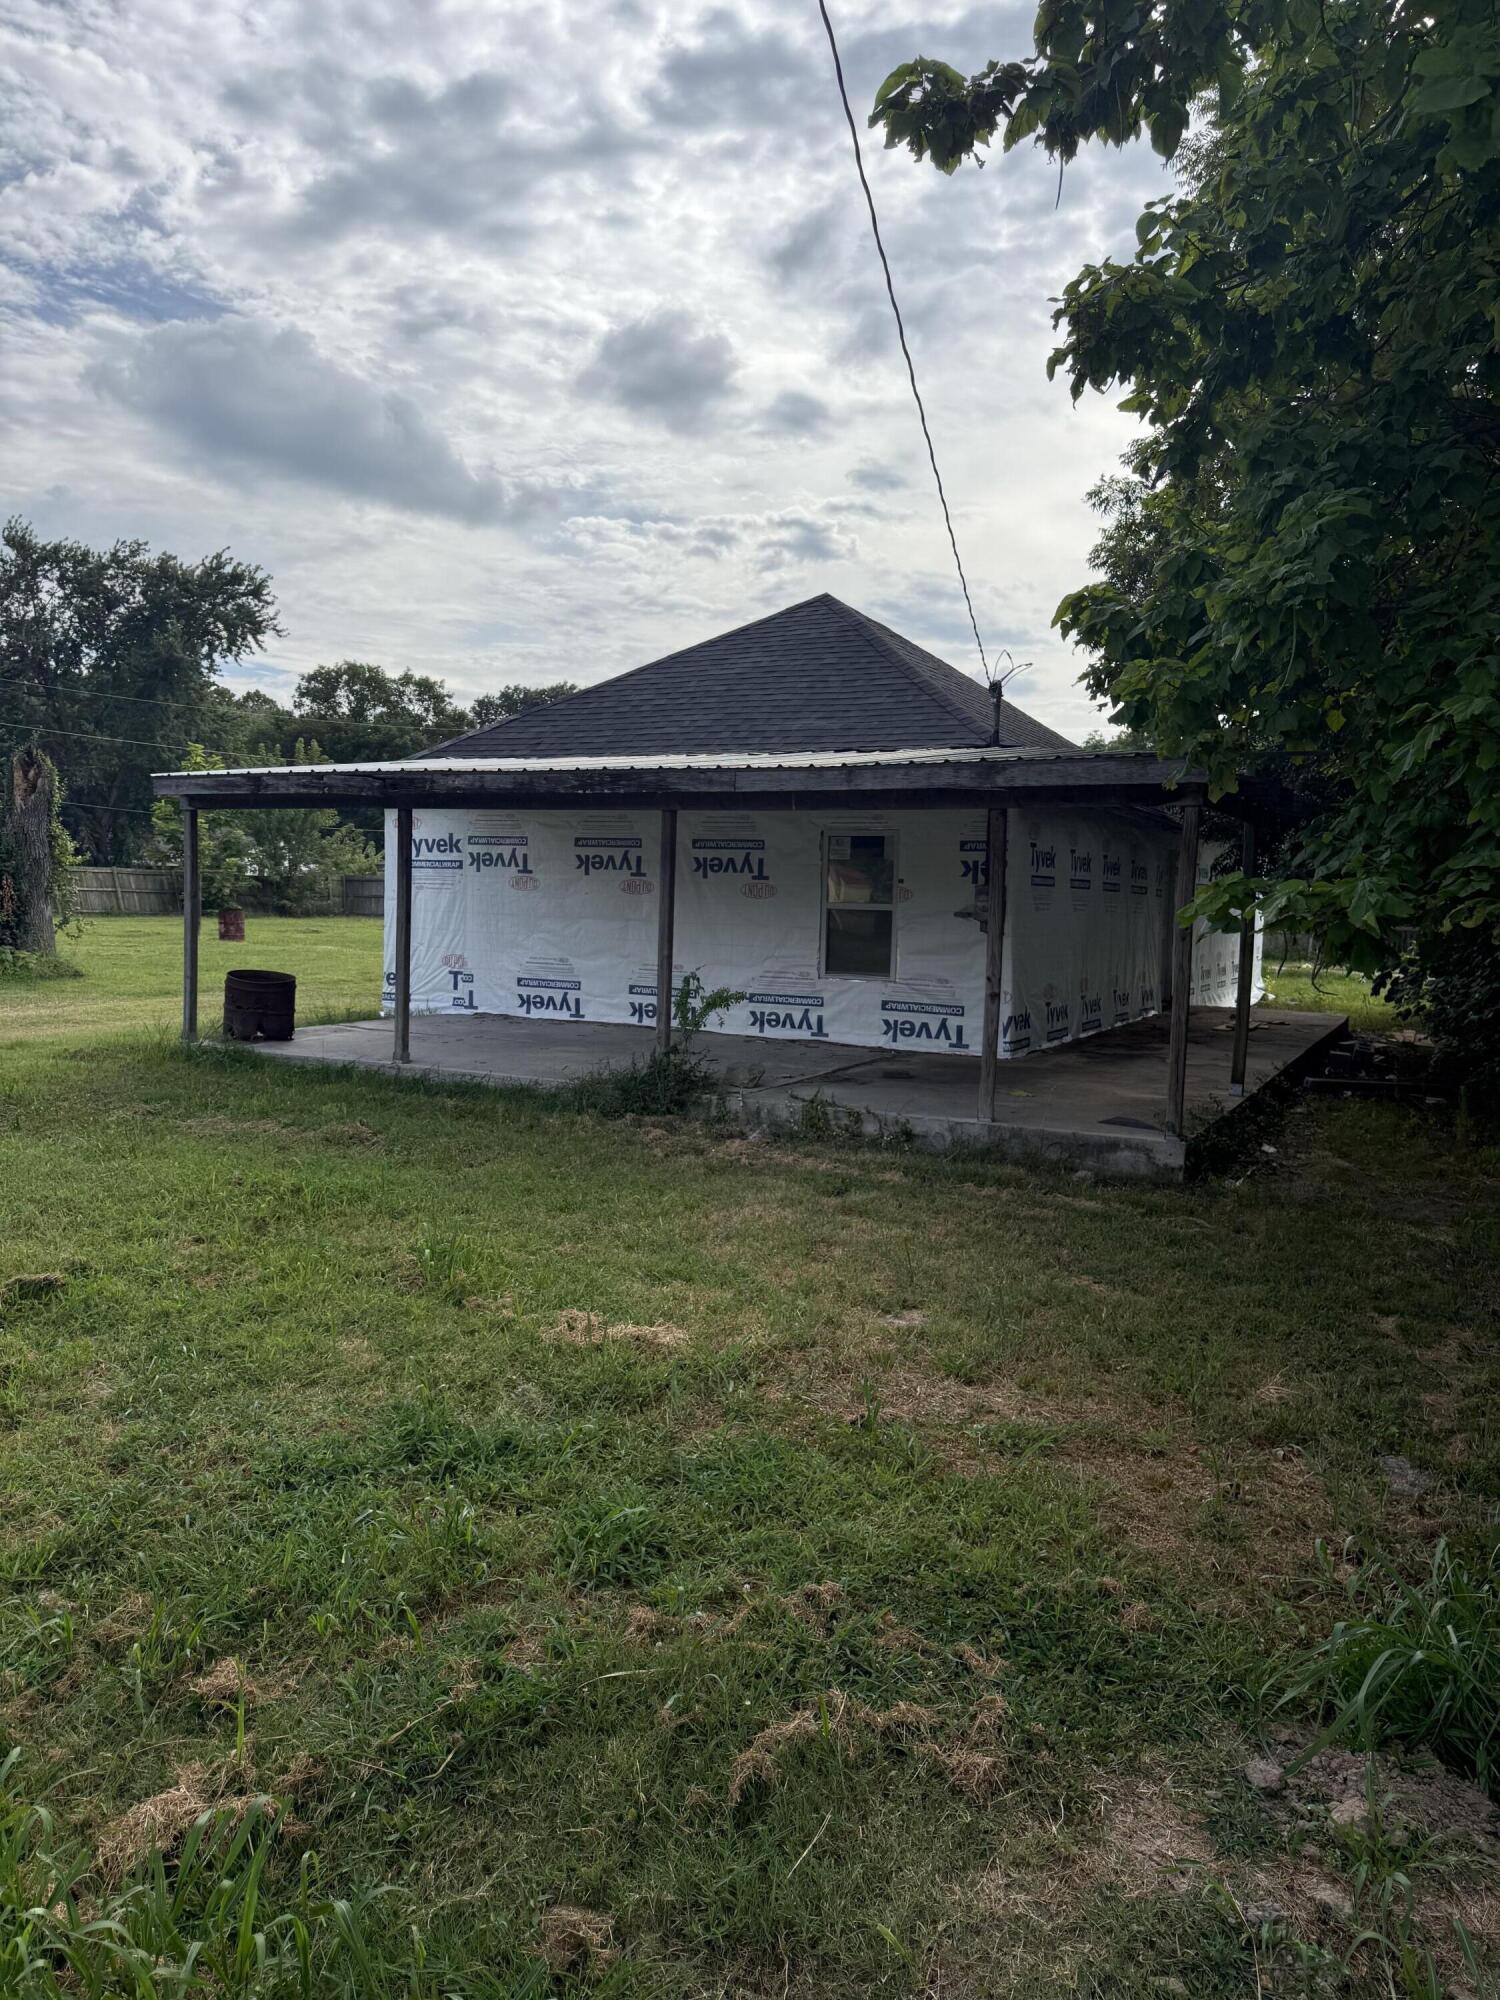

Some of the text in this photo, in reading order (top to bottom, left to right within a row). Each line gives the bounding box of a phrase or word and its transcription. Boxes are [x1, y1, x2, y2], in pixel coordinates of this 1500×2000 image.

[411, 833, 463, 857] yvek
[1030, 842, 1056, 872] Tyvek
[468, 848, 533, 874] Tyvek
[576, 850, 647, 877] Tyvek
[693, 853, 769, 880] Tyvek
[518, 992, 585, 1018] Tyvek
[750, 1008, 829, 1038] Tyvek
[881, 1018, 969, 1048] Tyvek
